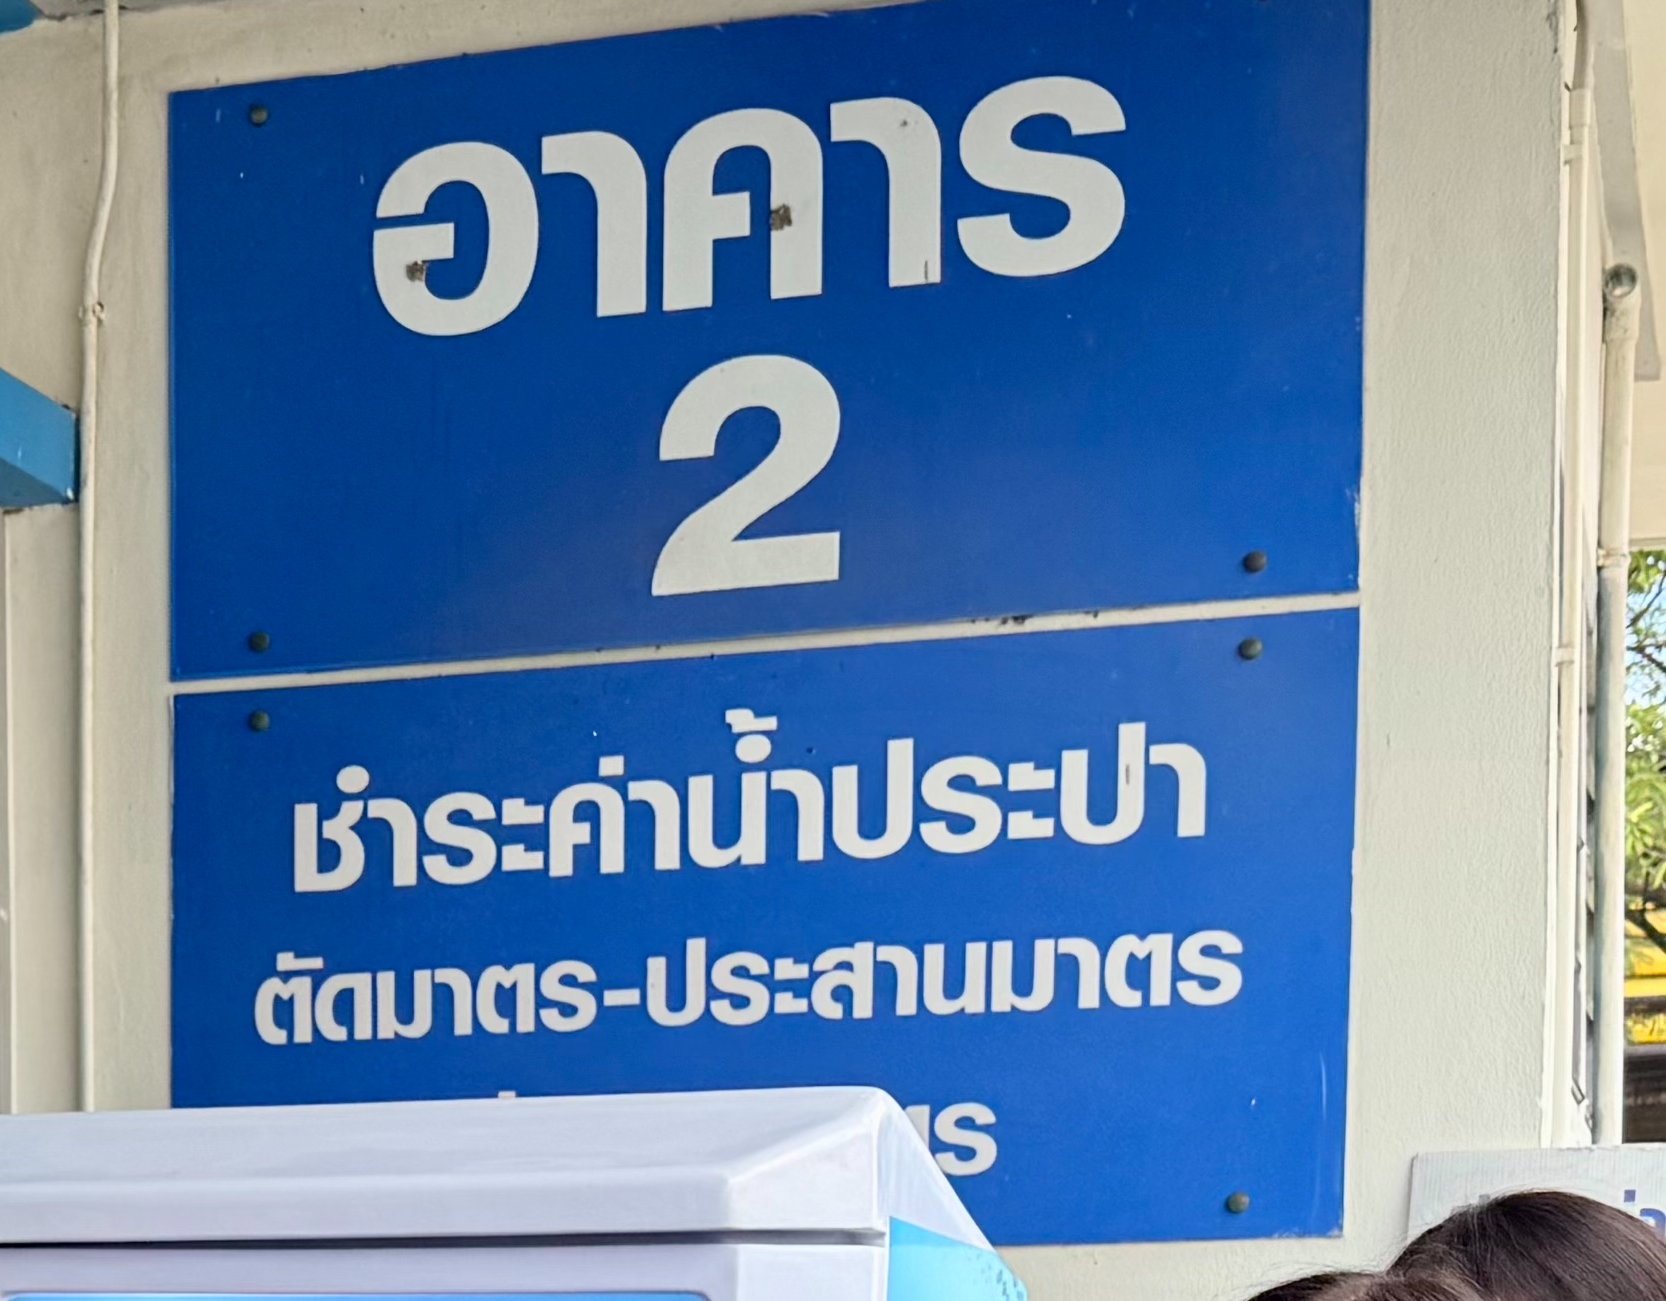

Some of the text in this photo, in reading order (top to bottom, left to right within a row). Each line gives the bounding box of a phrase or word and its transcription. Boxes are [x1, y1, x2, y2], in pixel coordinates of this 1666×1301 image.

[372, 75, 1126, 336] อาคาร
[651, 355, 841, 596] 2
[293, 708, 1207, 893] ชำระค่าน้ำประปา
[254, 929, 1244, 1046] ตัดมาตร-ประสานมาตร
